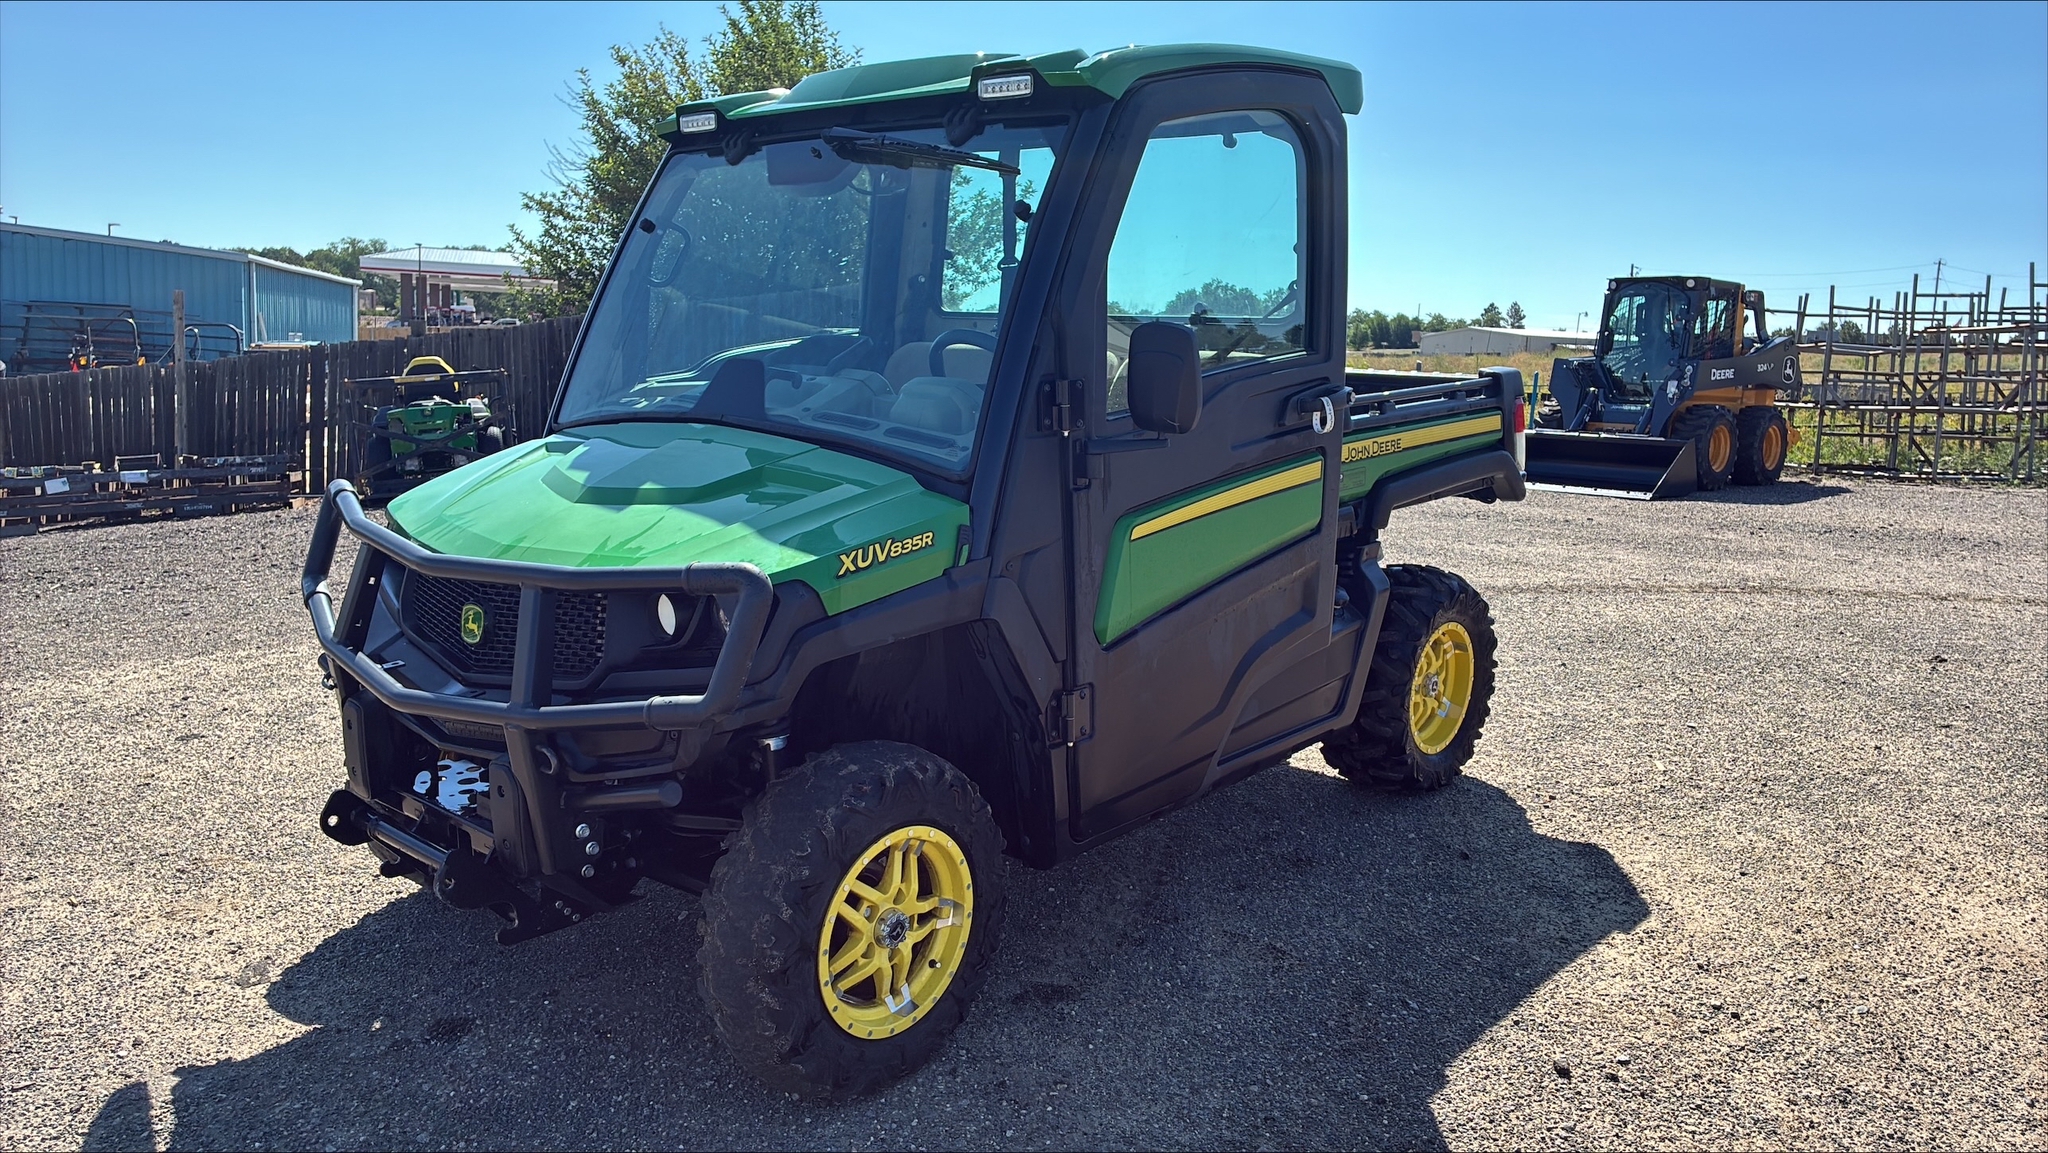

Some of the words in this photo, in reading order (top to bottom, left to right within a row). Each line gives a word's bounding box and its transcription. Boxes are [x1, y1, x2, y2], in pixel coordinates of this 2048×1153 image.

[1710, 368, 1735, 381] DEERE
[1344, 444, 1371, 462] JOHN
[1372, 438, 1403, 456] DEERE
[837, 530, 934, 577] XUV835R
